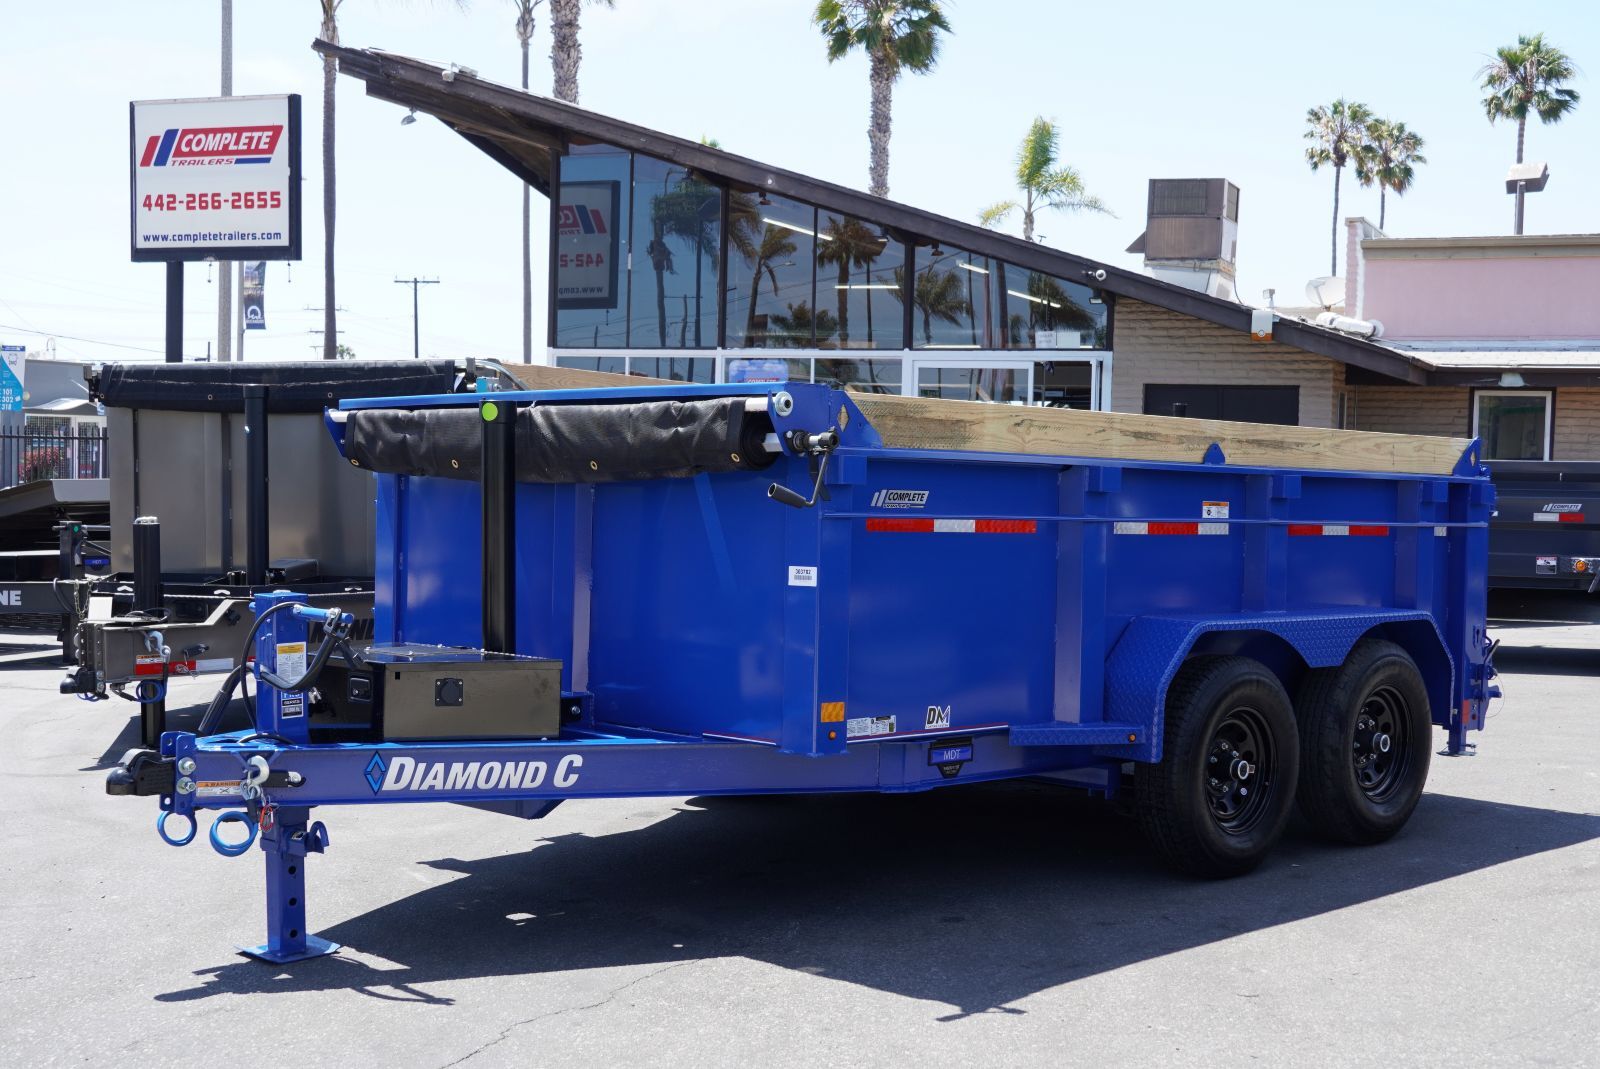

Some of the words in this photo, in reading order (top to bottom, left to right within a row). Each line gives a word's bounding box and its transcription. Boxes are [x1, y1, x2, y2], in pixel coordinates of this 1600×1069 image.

[180, 131, 273, 152] COMPLETE
[171, 158, 234, 167] TRAILERS
[143, 191, 281, 211] 442-266-2655
[143, 231, 281, 243] www.completetrailers.com
[888, 492, 926, 502] COMPLETE
[943, 749, 961, 760] MDT
[553, 753, 583, 788] C
